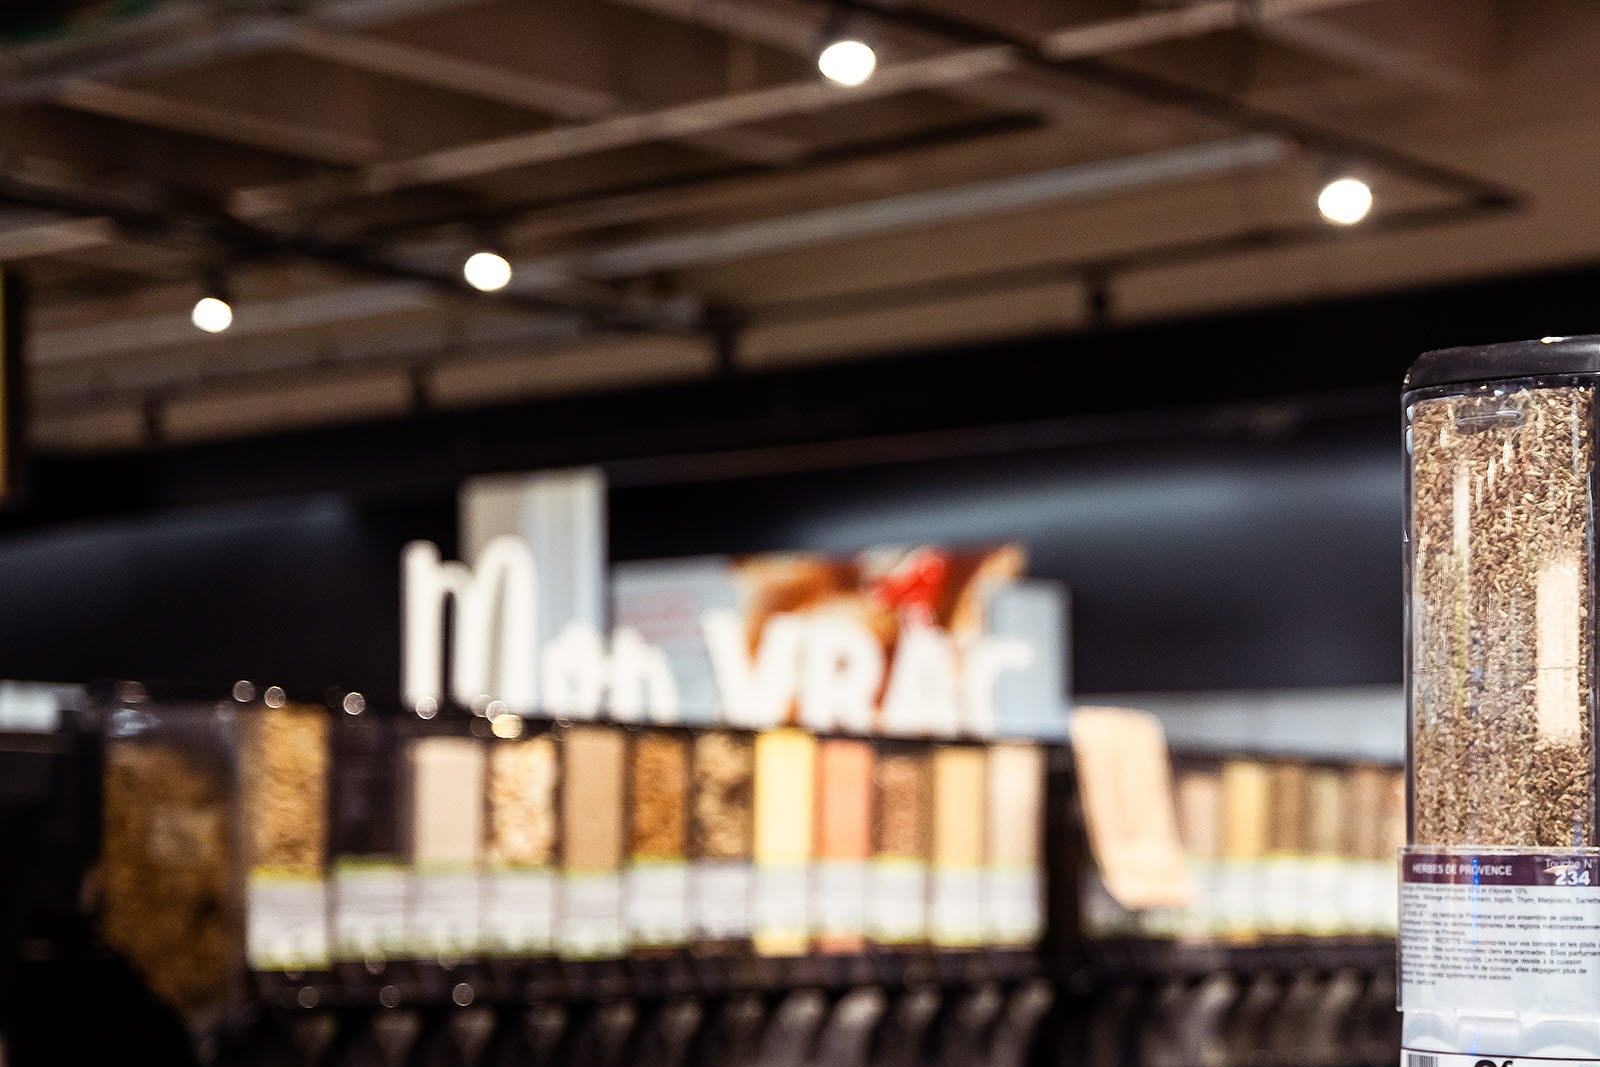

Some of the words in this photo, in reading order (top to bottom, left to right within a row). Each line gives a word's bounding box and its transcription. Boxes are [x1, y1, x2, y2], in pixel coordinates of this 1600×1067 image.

[1412, 864, 1443, 875] HERBES
[1446, 864, 1457, 875] DE
[1459, 865, 1512, 875] PROVENCE
[1555, 871, 1590, 885] 234
